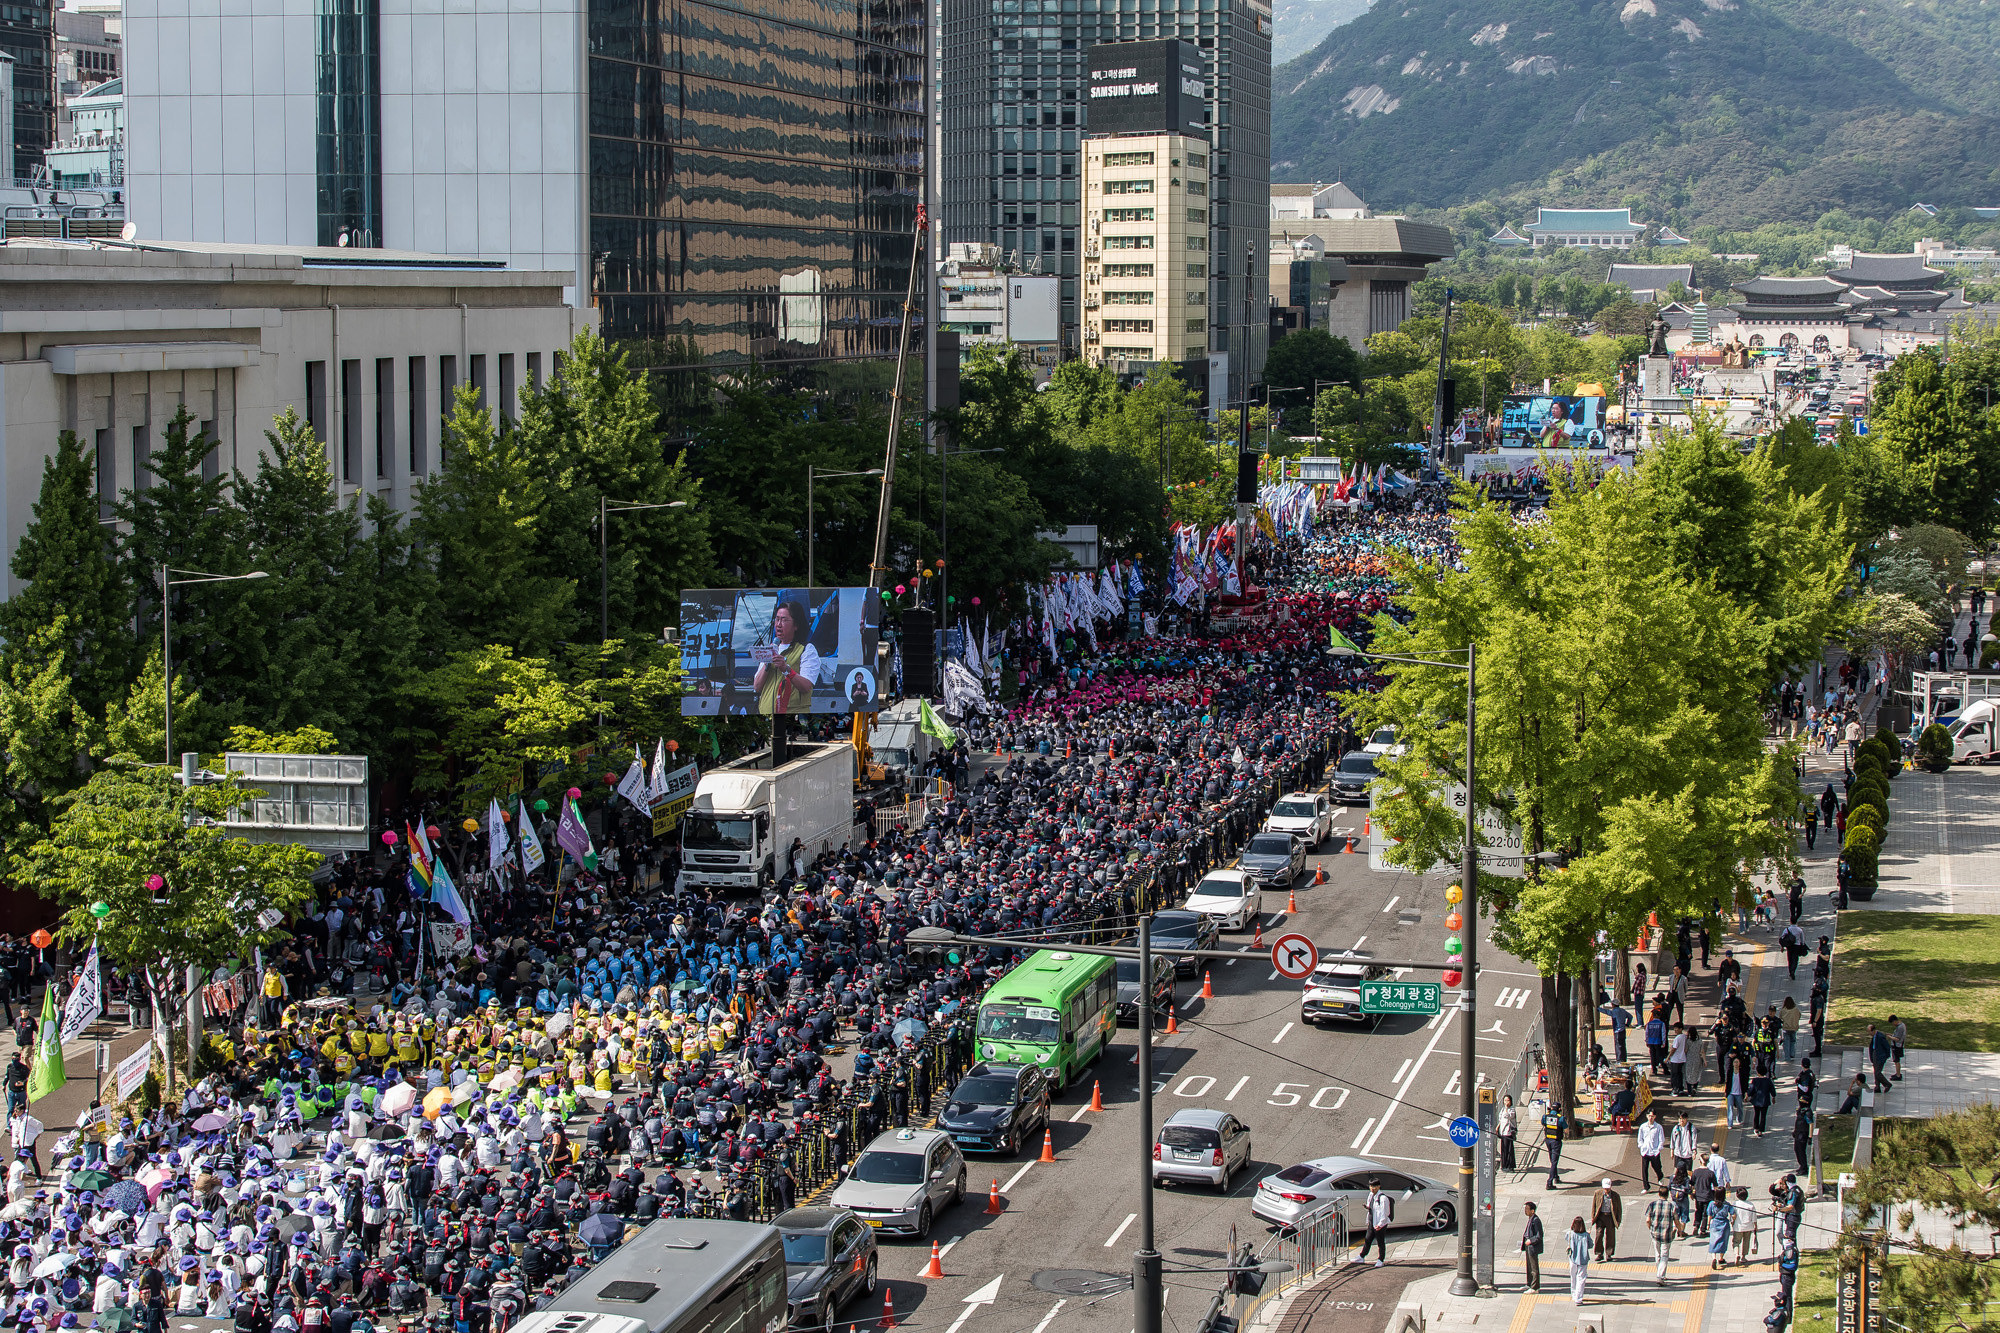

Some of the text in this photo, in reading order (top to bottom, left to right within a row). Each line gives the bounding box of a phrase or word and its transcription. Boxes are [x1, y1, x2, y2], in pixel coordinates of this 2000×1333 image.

[1091, 82, 1159, 98] SAMSUNG Wallet
[1014, 285, 1022, 299] LET
[1380, 986, 1436, 1001] 청계광장
[1379, 999, 1415, 1010] Cheonggye
[1417, 1000, 1436, 1010] Plaza
[1266, 1082, 1351, 1111] 50
[1484, 1140, 1492, 1157] 타는
